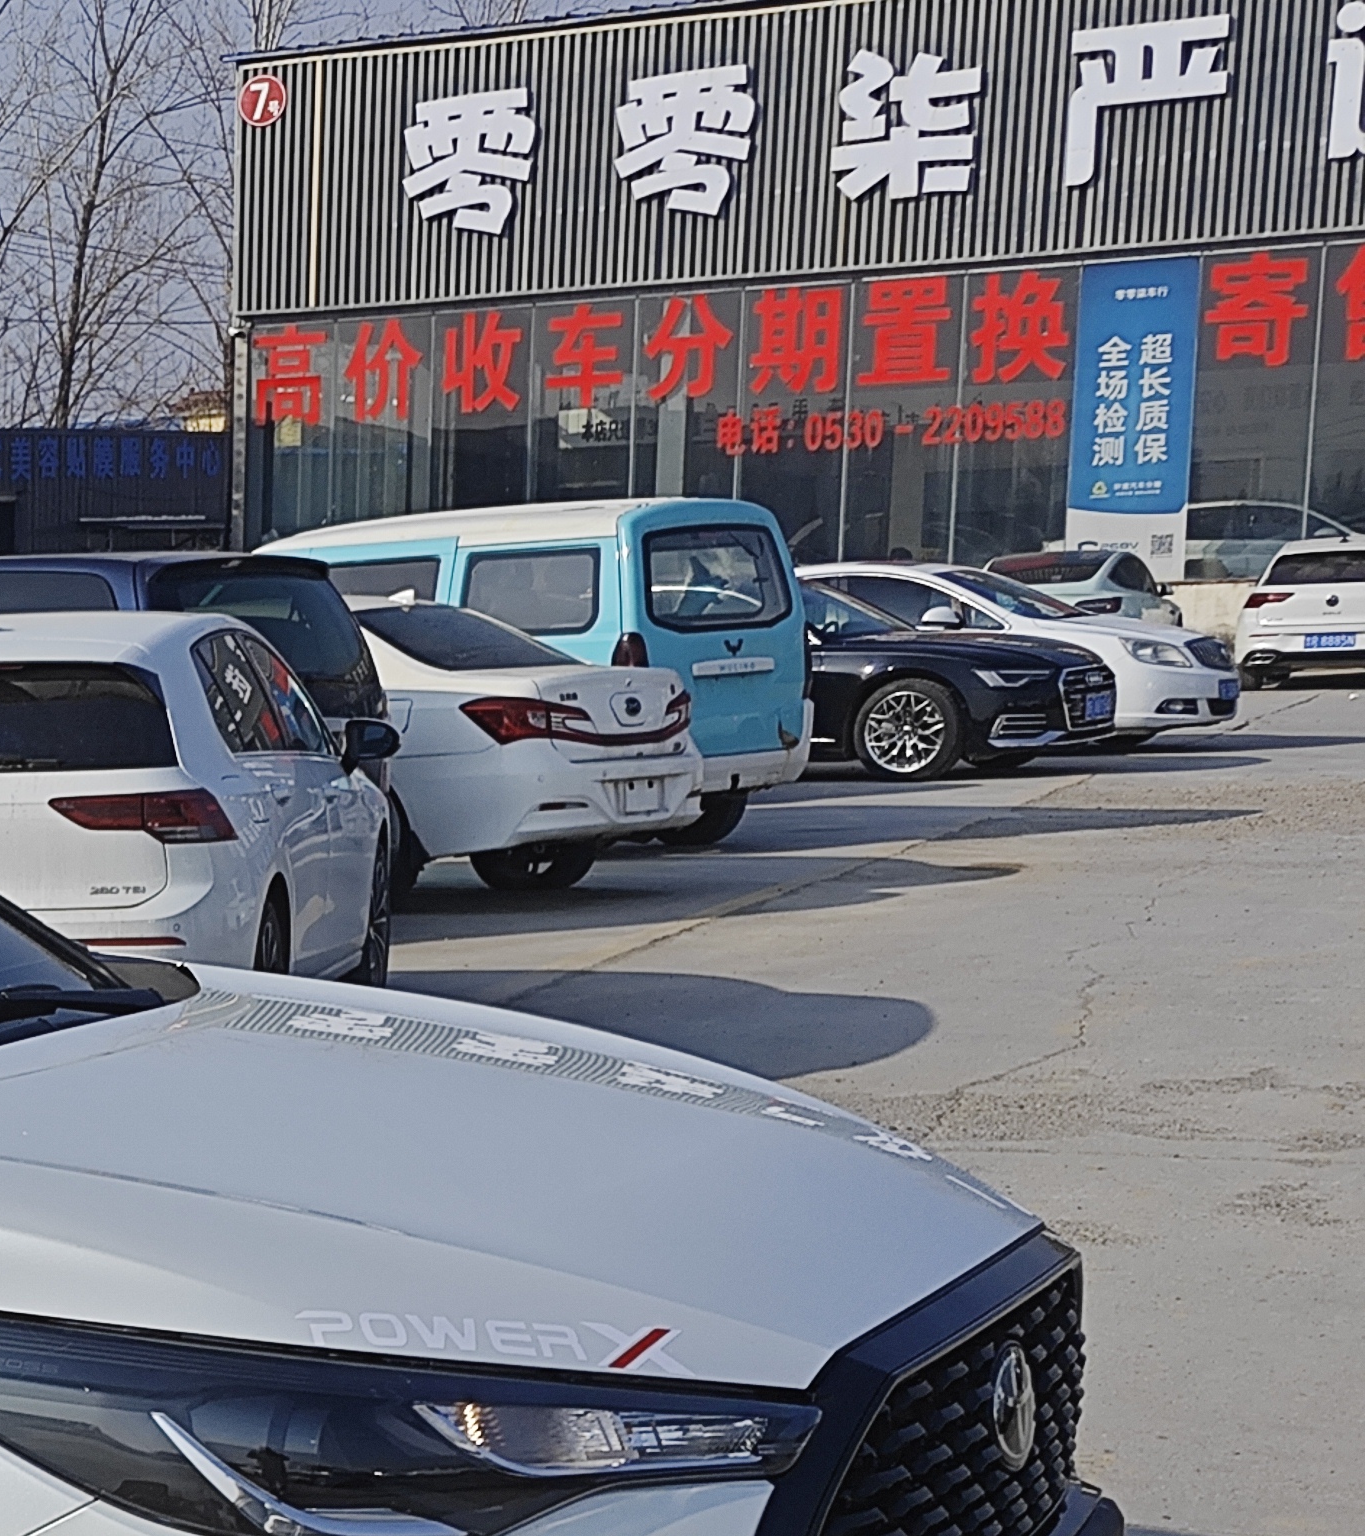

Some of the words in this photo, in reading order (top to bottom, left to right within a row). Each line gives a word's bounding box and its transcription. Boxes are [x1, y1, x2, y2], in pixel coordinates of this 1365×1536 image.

[252, 270, 1068, 425] 高价收车分期置换
[1091, 335, 1132, 467] 全场检测
[1136, 333, 1173, 465] 超长质保
